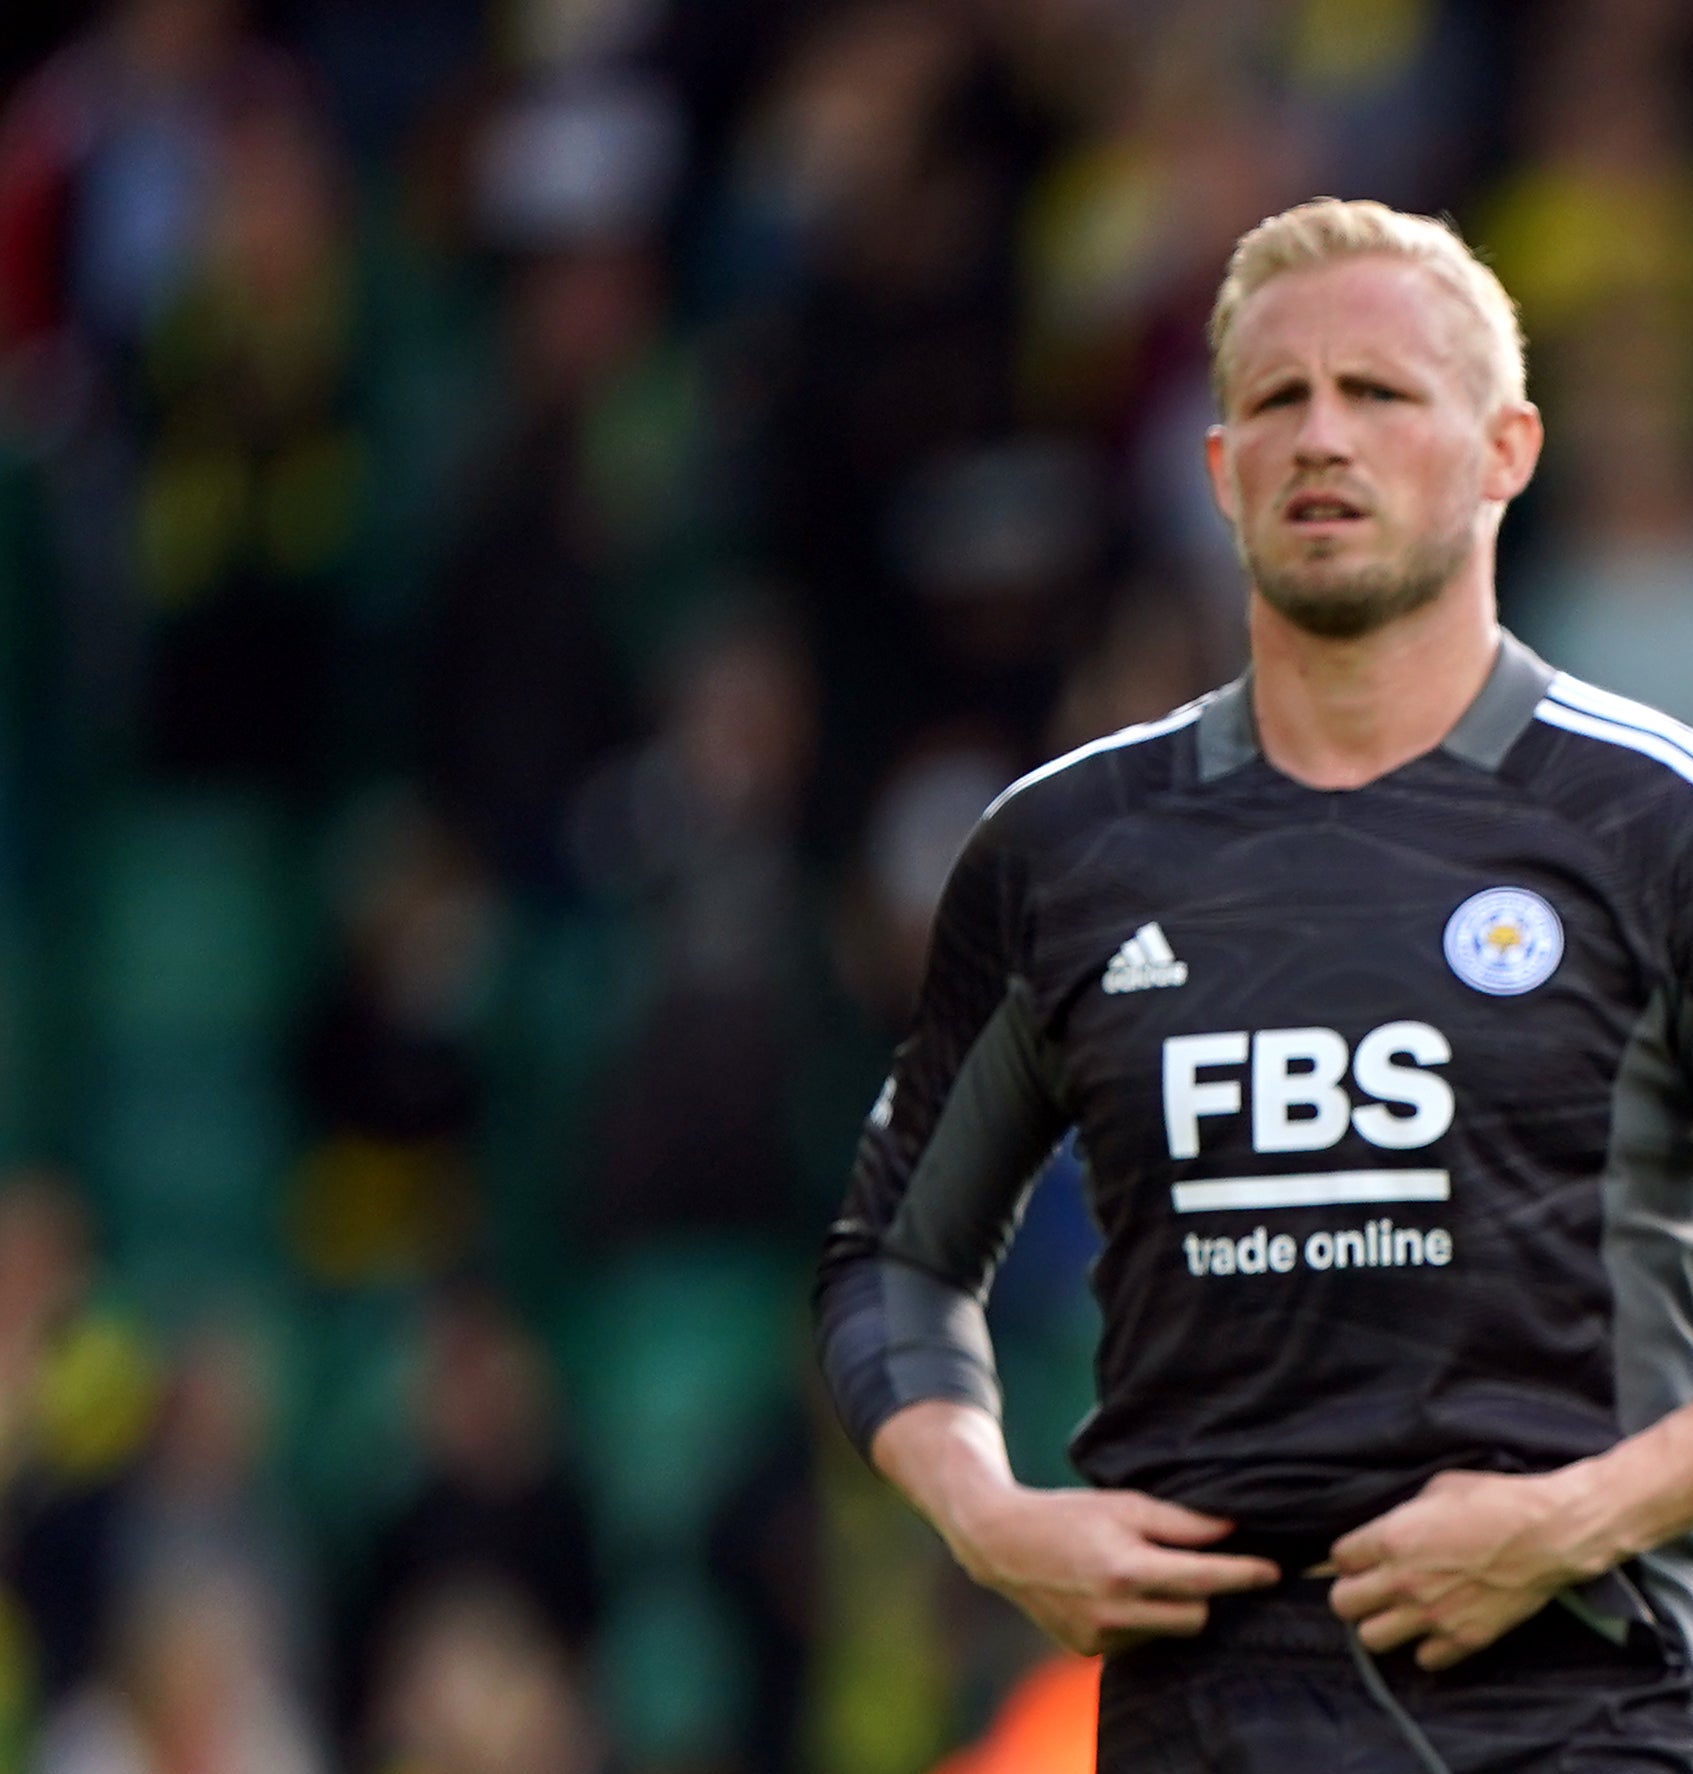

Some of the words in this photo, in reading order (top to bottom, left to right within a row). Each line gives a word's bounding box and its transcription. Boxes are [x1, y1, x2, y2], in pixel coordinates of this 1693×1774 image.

[1162, 1020, 1456, 1160] FBS
[1182, 1225, 1297, 1276] trade
[1304, 1217, 1452, 1271] online
